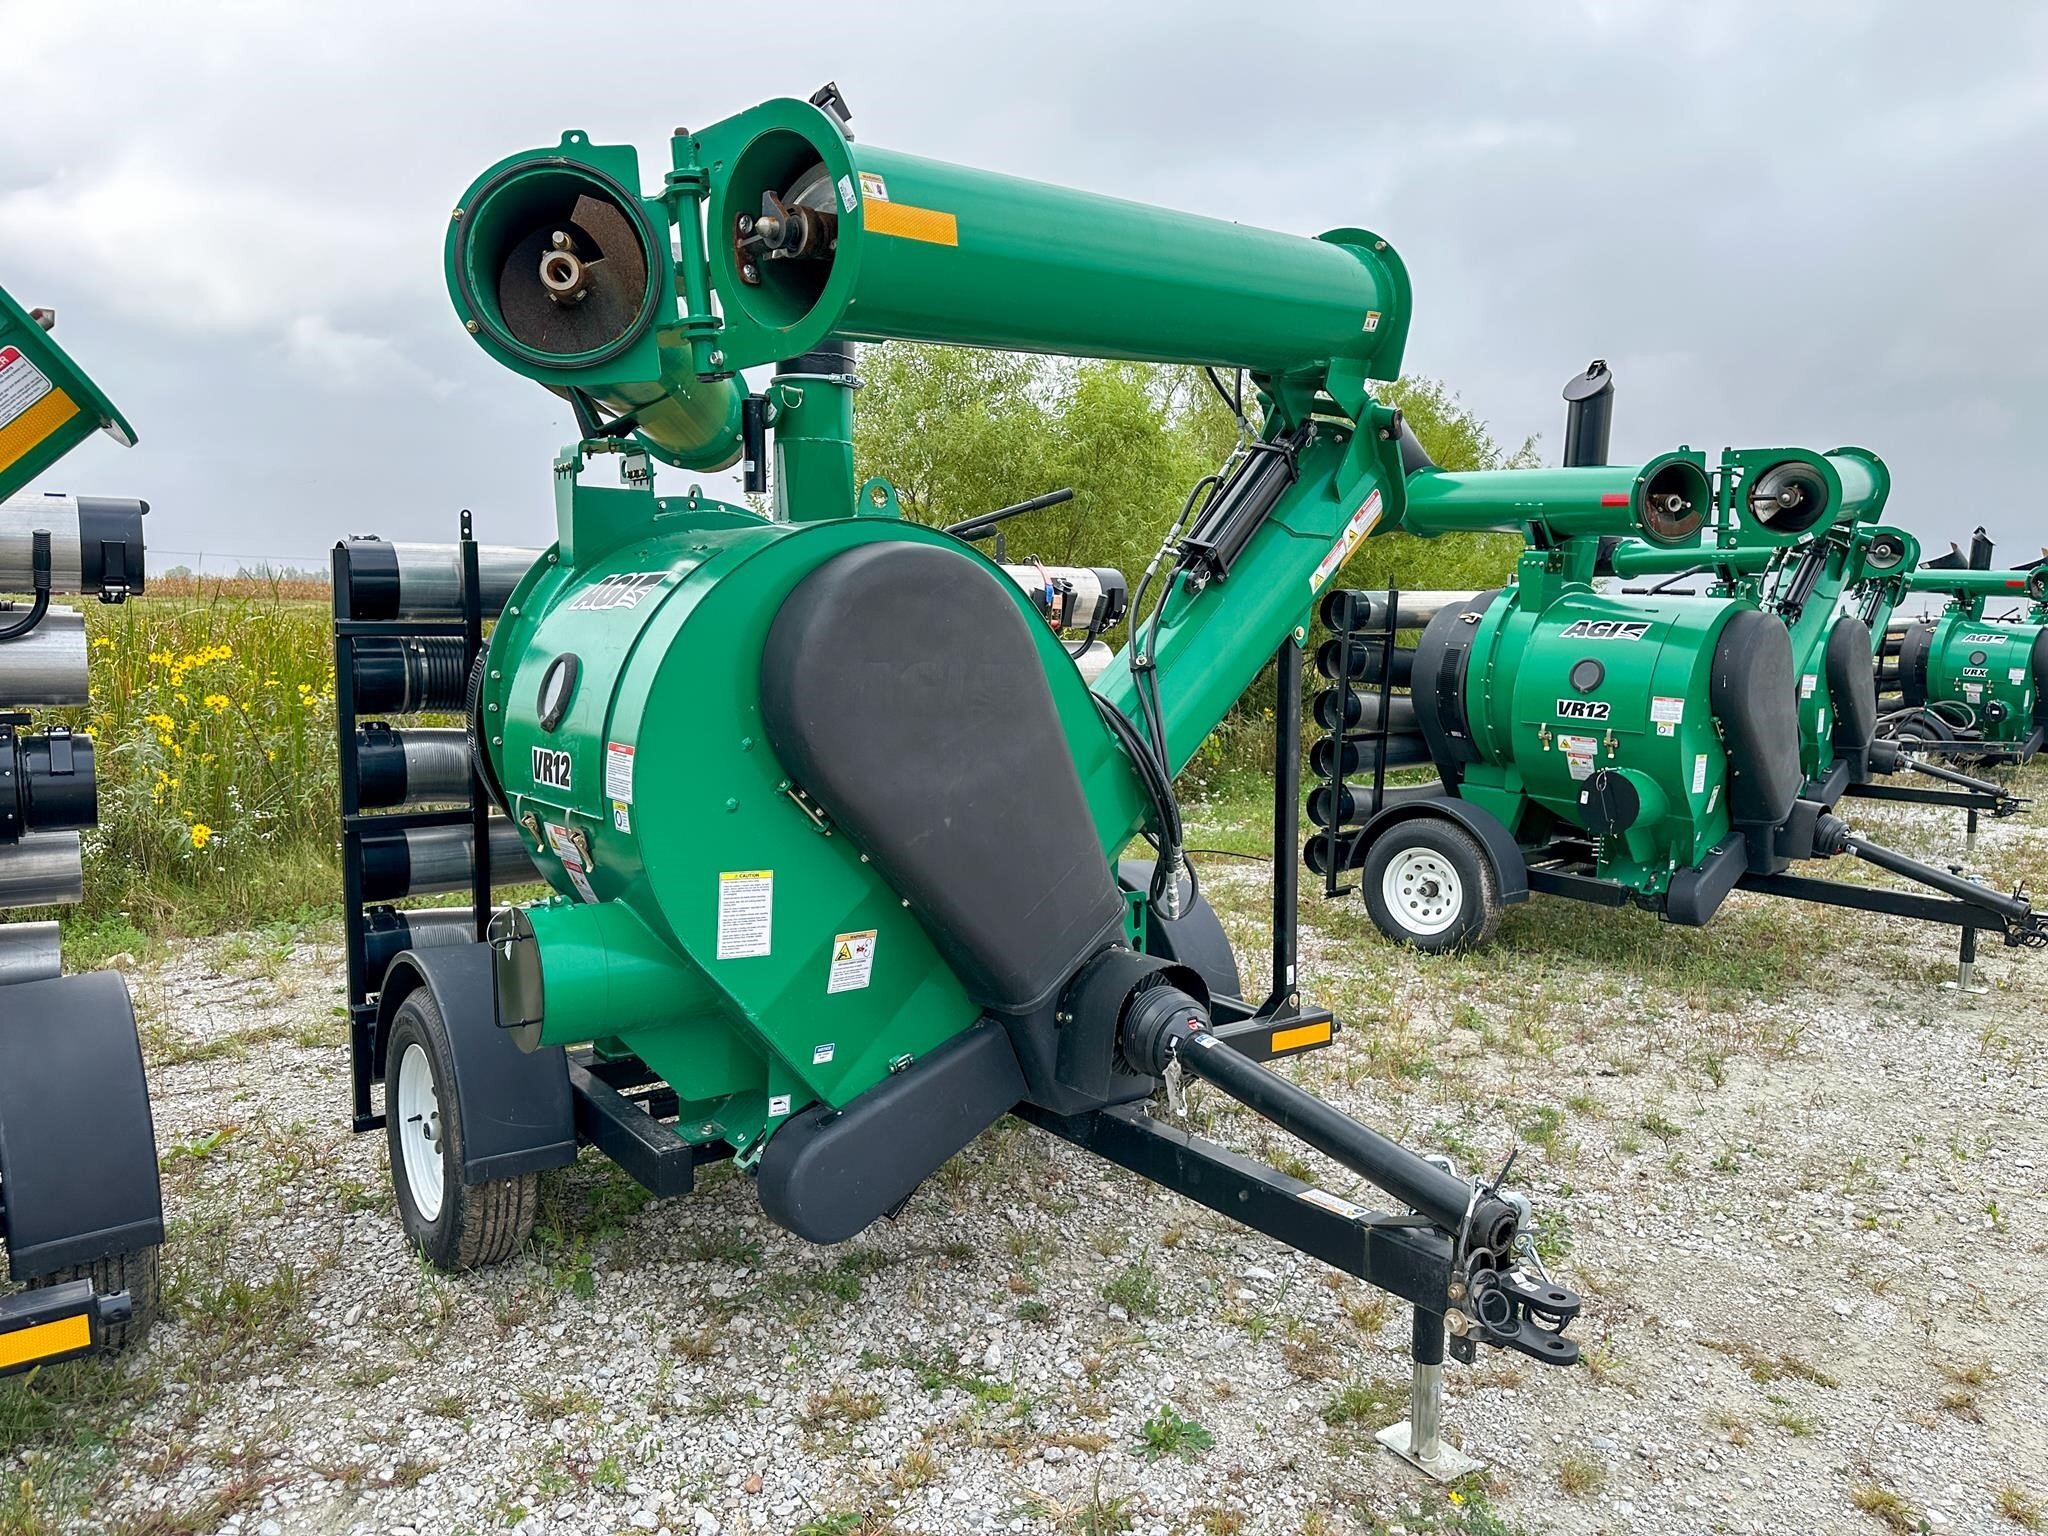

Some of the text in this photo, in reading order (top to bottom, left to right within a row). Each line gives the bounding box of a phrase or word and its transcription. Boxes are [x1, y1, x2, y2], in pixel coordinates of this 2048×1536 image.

[571, 573, 647, 608] AGI
[1563, 621, 1623, 639] AGI
[1965, 634, 1995, 642] AGI
[1963, 668, 1986, 676] VRX
[1558, 700, 1609, 719] VR12
[533, 749, 571, 788] VR12
